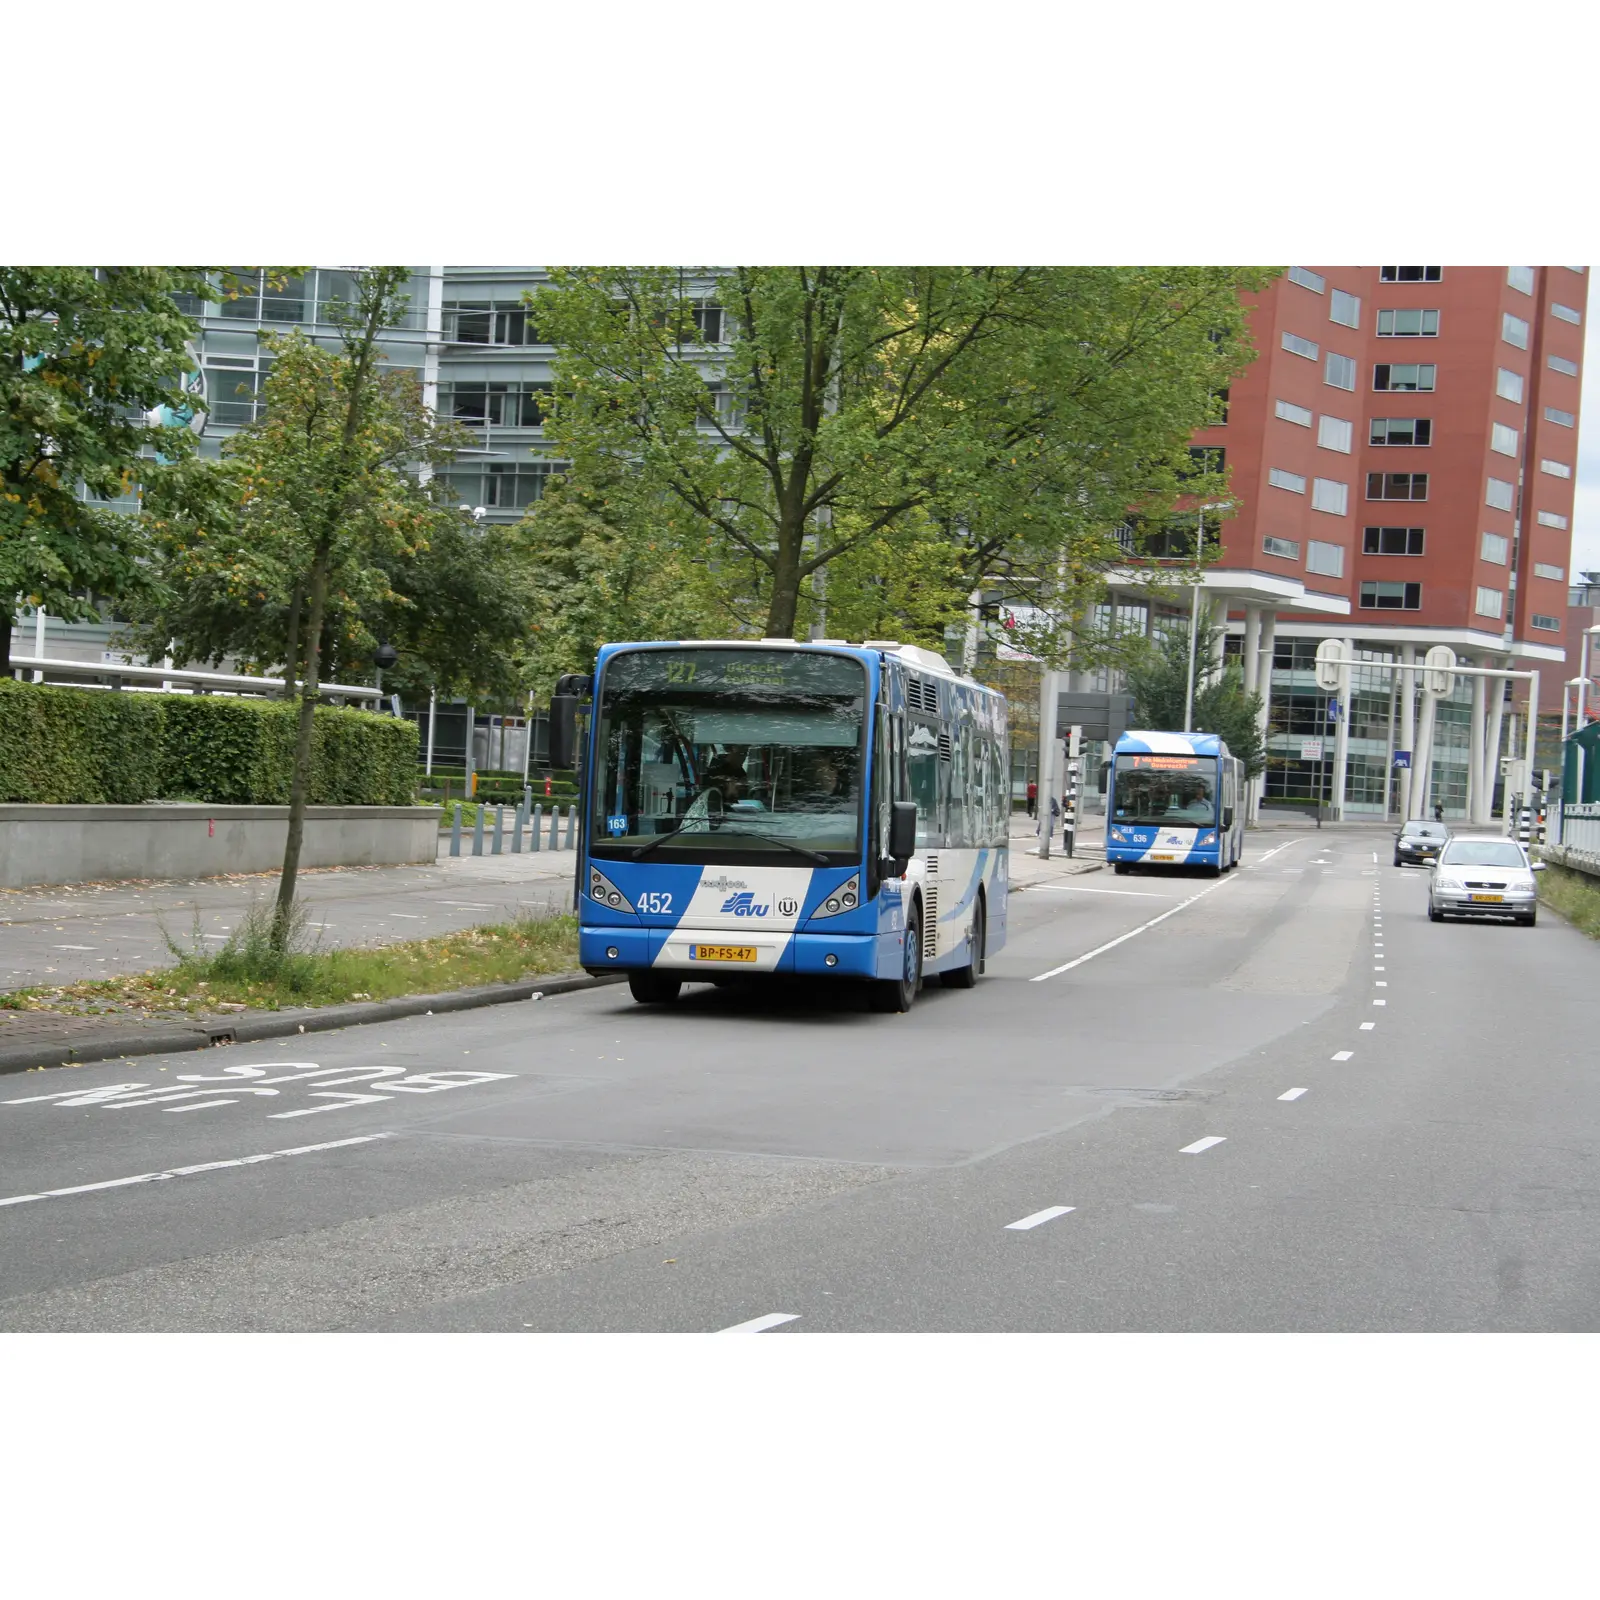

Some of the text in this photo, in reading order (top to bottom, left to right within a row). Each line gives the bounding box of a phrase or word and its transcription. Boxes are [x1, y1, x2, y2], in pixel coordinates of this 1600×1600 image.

[667, 662, 696, 684] 127
[1132, 756, 1140, 768] 7
[608, 818, 625, 829] 163
[1133, 834, 1147, 843] 636
[637, 892, 673, 914] 452
[700, 946, 752, 960] BP-FS-47
